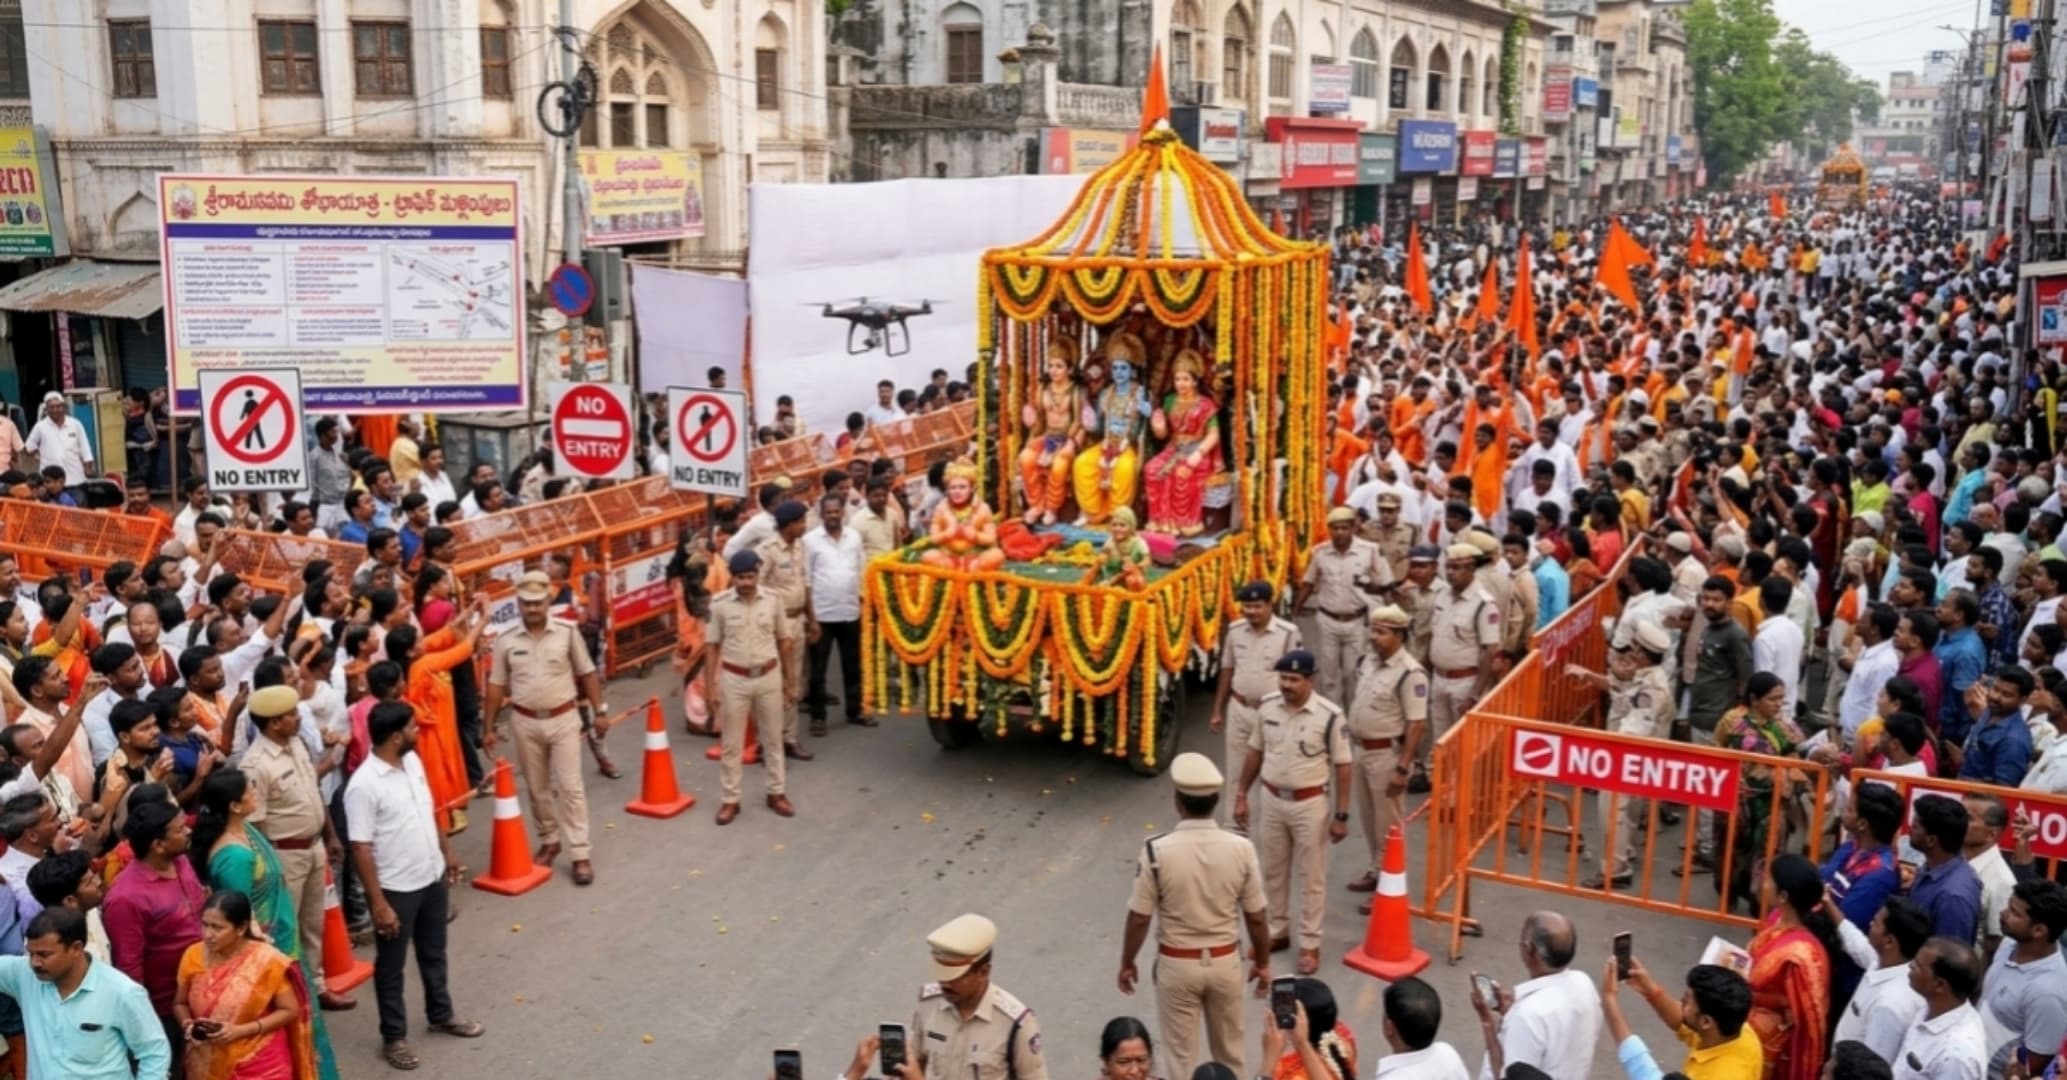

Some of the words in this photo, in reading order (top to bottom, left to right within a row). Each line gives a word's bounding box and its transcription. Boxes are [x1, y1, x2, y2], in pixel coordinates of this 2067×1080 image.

[576, 396, 606, 415] NO
[565, 440, 621, 459] ENTRY
[215, 470, 240, 485] NO
[244, 469, 300, 485] ENTRY
[674, 465, 694, 482] NO
[697, 468, 741, 487] ENTRY
[1567, 745, 1612, 779] NO
[1621, 754, 1729, 797] ENTRY
